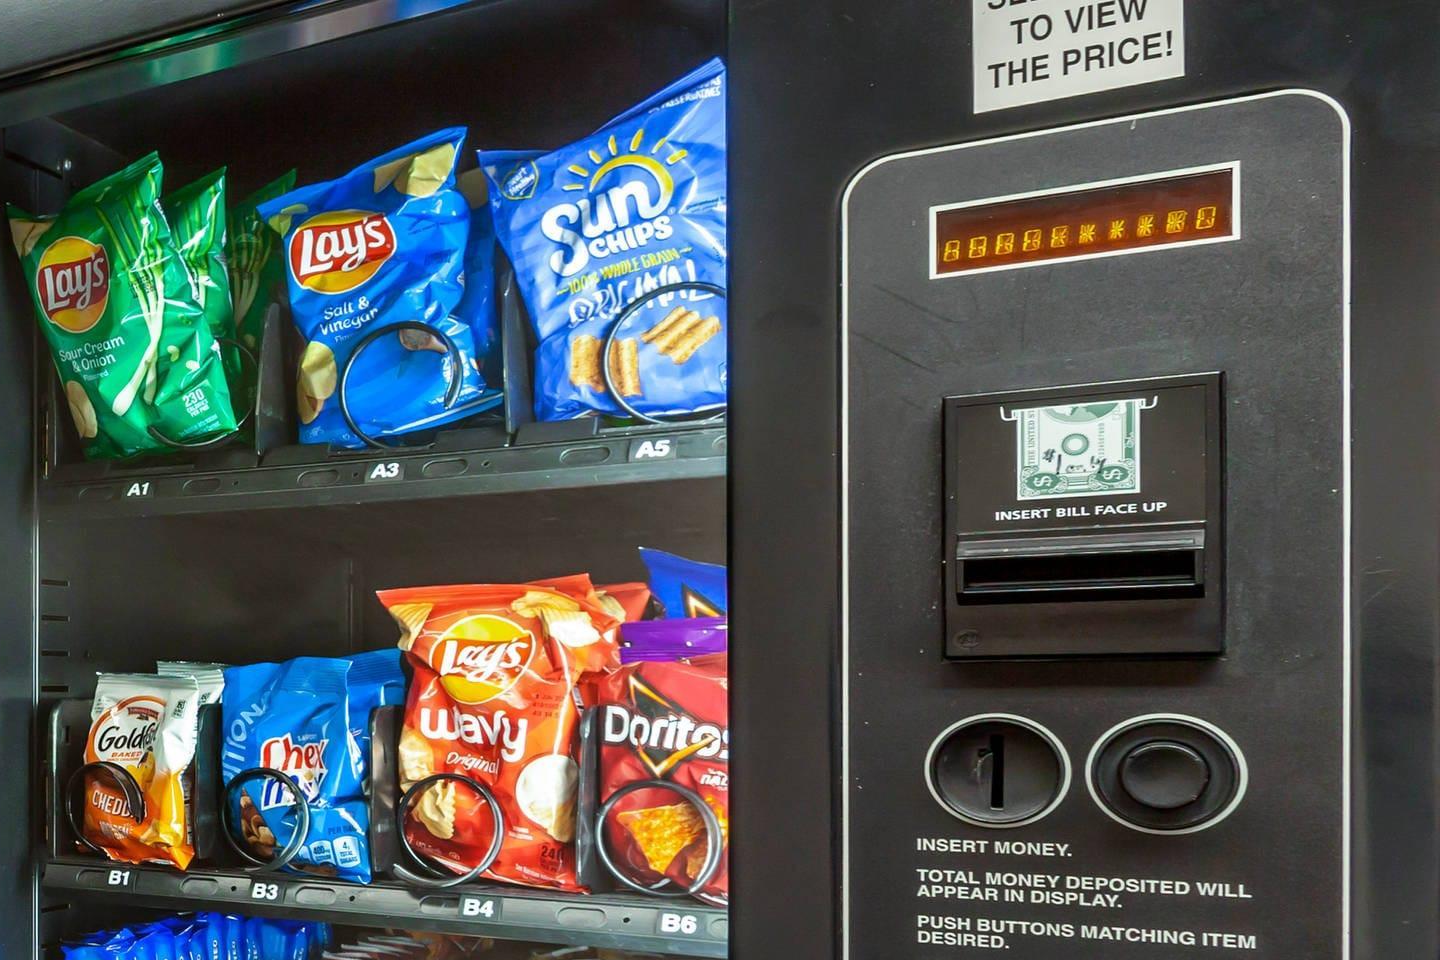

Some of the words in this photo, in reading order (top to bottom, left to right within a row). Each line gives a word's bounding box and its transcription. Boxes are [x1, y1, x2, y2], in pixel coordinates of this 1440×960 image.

[1011, 15, 1052, 45] TO
[1065, 0, 1147, 33] VIEW
[988, 54, 1050, 88] THE
[1062, 31, 1173, 76] PRICE!
[541, 178, 674, 277] Sun
[588, 215, 673, 259] CHIPS
[300, 217, 386, 276] Lay's
[601, 256, 641, 280] WHOLE
[642, 248, 681, 269] GRAIN
[44, 253, 104, 312] Lay's
[324, 302, 353, 321] Salt
[358, 295, 370, 312] &
[319, 307, 378, 336] Vinegar
[59, 347, 83, 362] Sour
[85, 335, 125, 355] Cream
[71, 360, 81, 373] &
[81, 353, 116, 371] Onion
[182, 388, 205, 407] 230
[635, 439, 671, 459] A5
[371, 463, 400, 479] A3
[127, 482, 150, 497] A1
[995, 508, 1051, 521] INSERT
[1056, 505, 1090, 518] BILL
[1095, 504, 1137, 516] FACE
[1142, 501, 1167, 513] UP
[441, 637, 529, 684] Lay's
[420, 707, 528, 763] wavy
[262, 736, 325, 772] Chex
[446, 751, 499, 775] Original
[92, 789, 148, 819] CHEDD
[916, 838, 988, 853] INSERT
[995, 841, 1073, 857] MONEY.
[108, 870, 131, 887] B1
[252, 883, 279, 900] B3
[916, 868, 980, 884] TOTAL
[985, 871, 1060, 889] MONEY
[1065, 875, 1190, 896] DEPOSITED
[1196, 881, 1253, 899] WILL
[463, 898, 495, 917] B4
[916, 885, 998, 901] APPEAR
[1004, 889, 1024, 903] IN
[1030, 890, 1123, 908] DISPLAY.
[661, 914, 698, 934] B6
[917, 915, 970, 931] PUSH
[977, 918, 1075, 938] BUTTONS
[1080, 924, 1196, 946] MATCHING
[1202, 932, 1257, 950] ITEM
[917, 931, 1010, 950] DESIRED.
